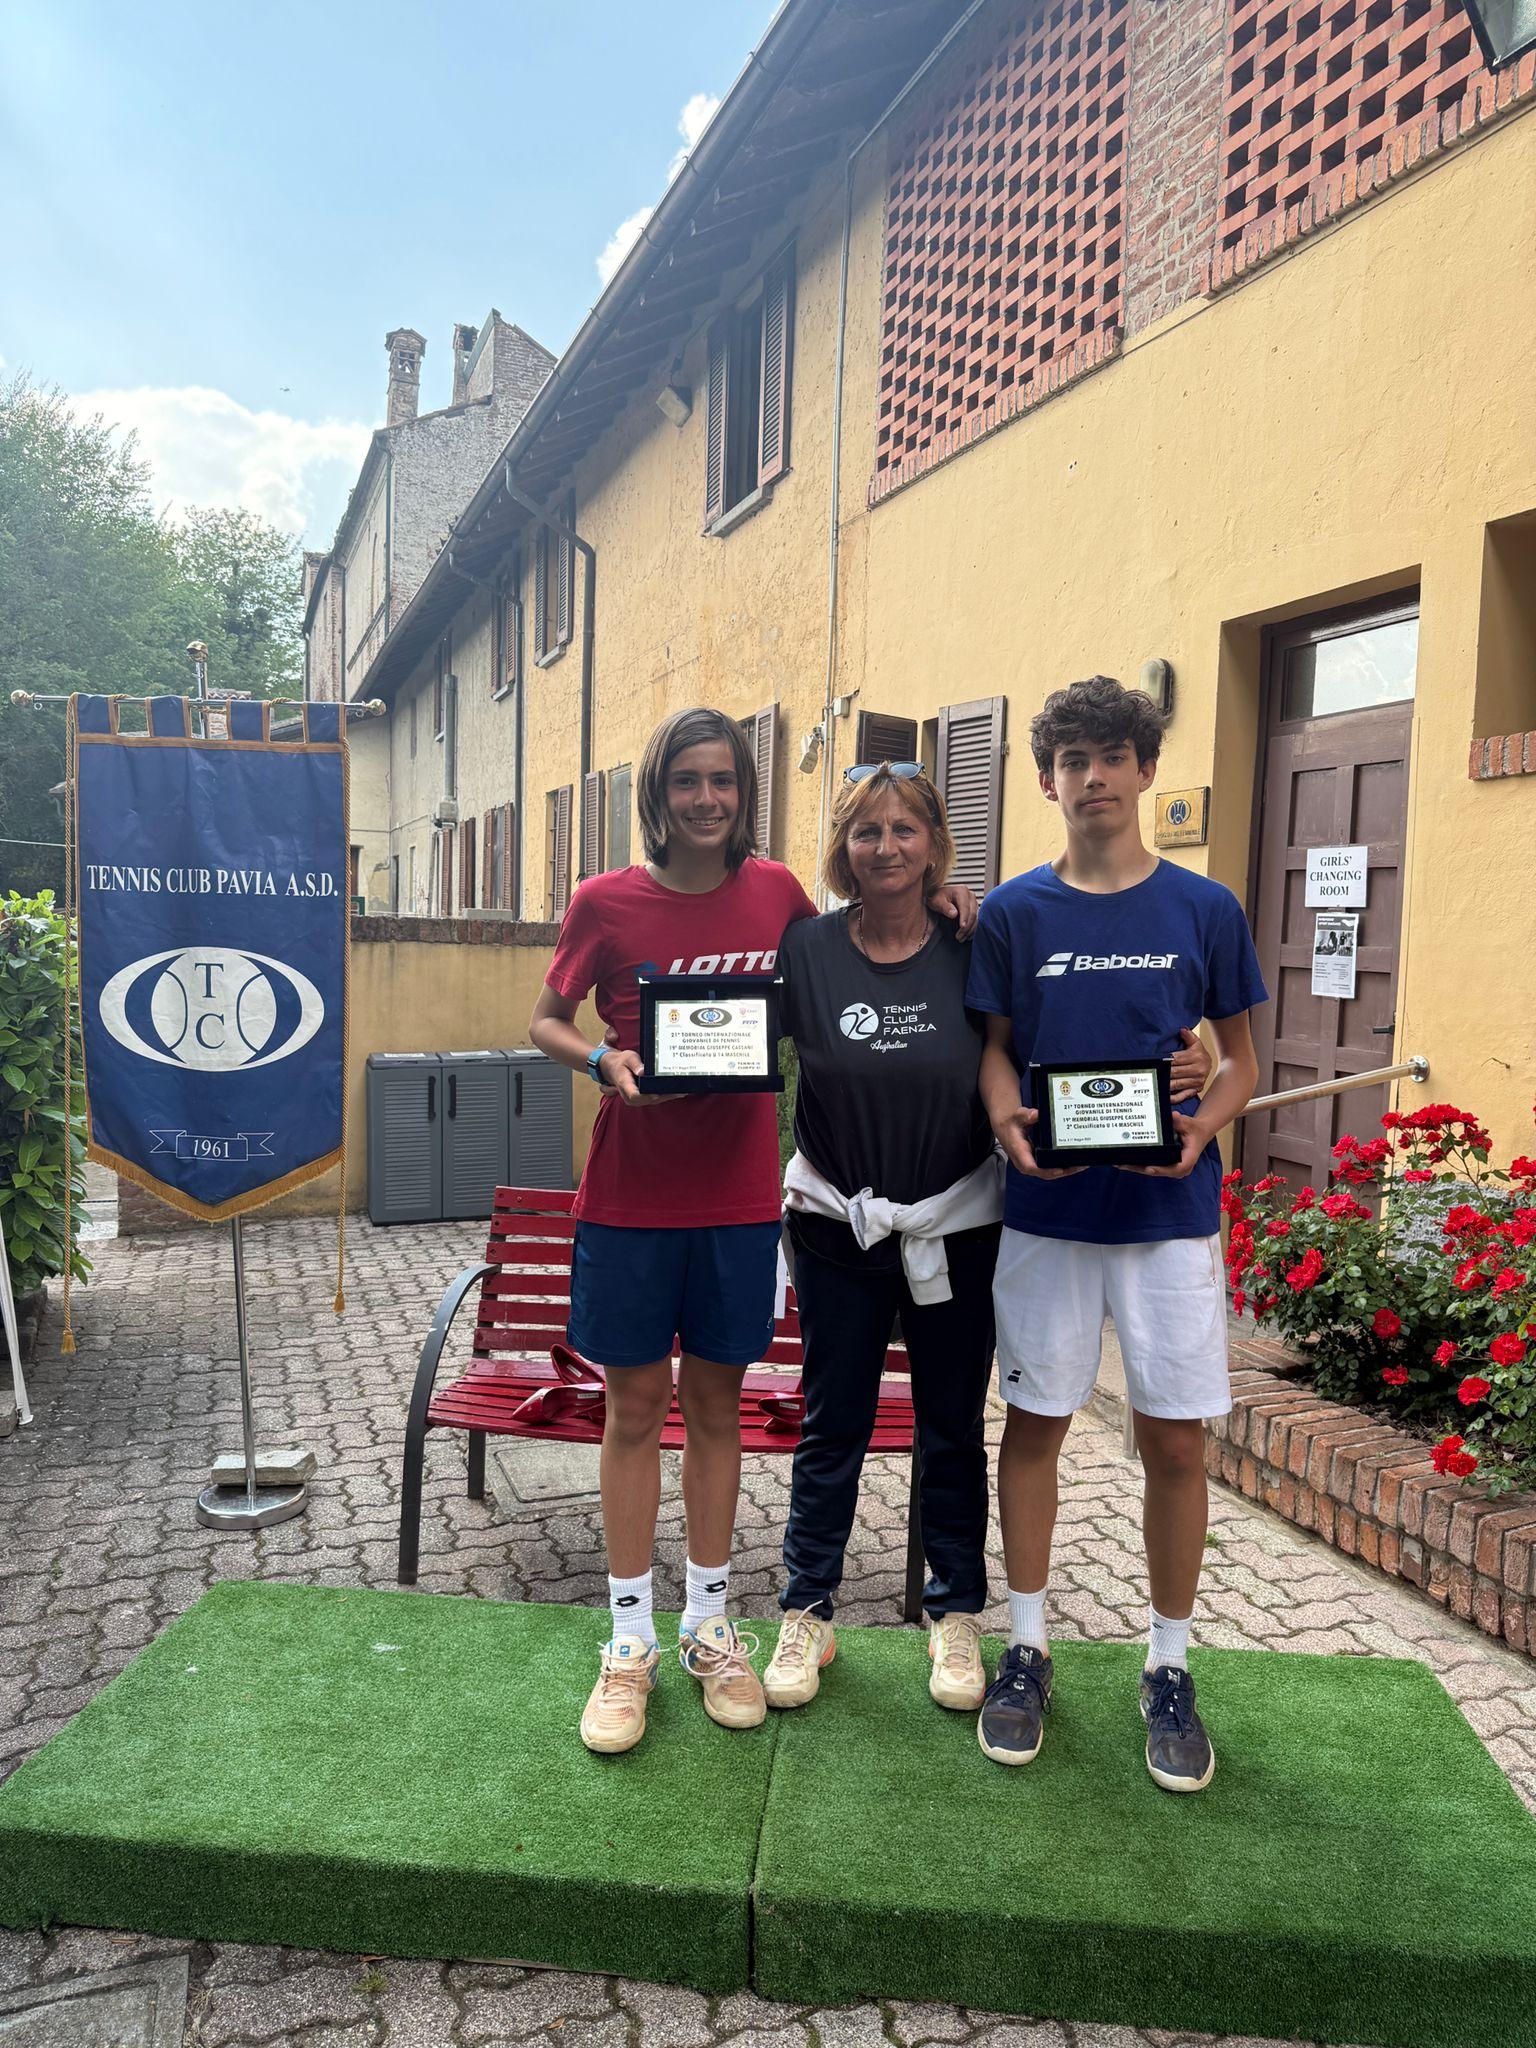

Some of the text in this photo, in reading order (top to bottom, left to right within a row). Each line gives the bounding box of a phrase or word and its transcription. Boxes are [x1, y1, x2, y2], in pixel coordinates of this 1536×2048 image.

[86, 864, 338, 898] TENNIS CLUB PAVIA A.S.D.
[1310, 870, 1362, 882] CHANGING
[1320, 886, 1349, 896] ROOM
[194, 962, 224, 998] T
[883, 1002, 927, 1014] TENNIS
[883, 1014, 918, 1024] CLUB
[195, 1013, 225, 1050] C
[883, 1023, 936, 1036] FAENZA
[193, 1138, 230, 1158] 1961
